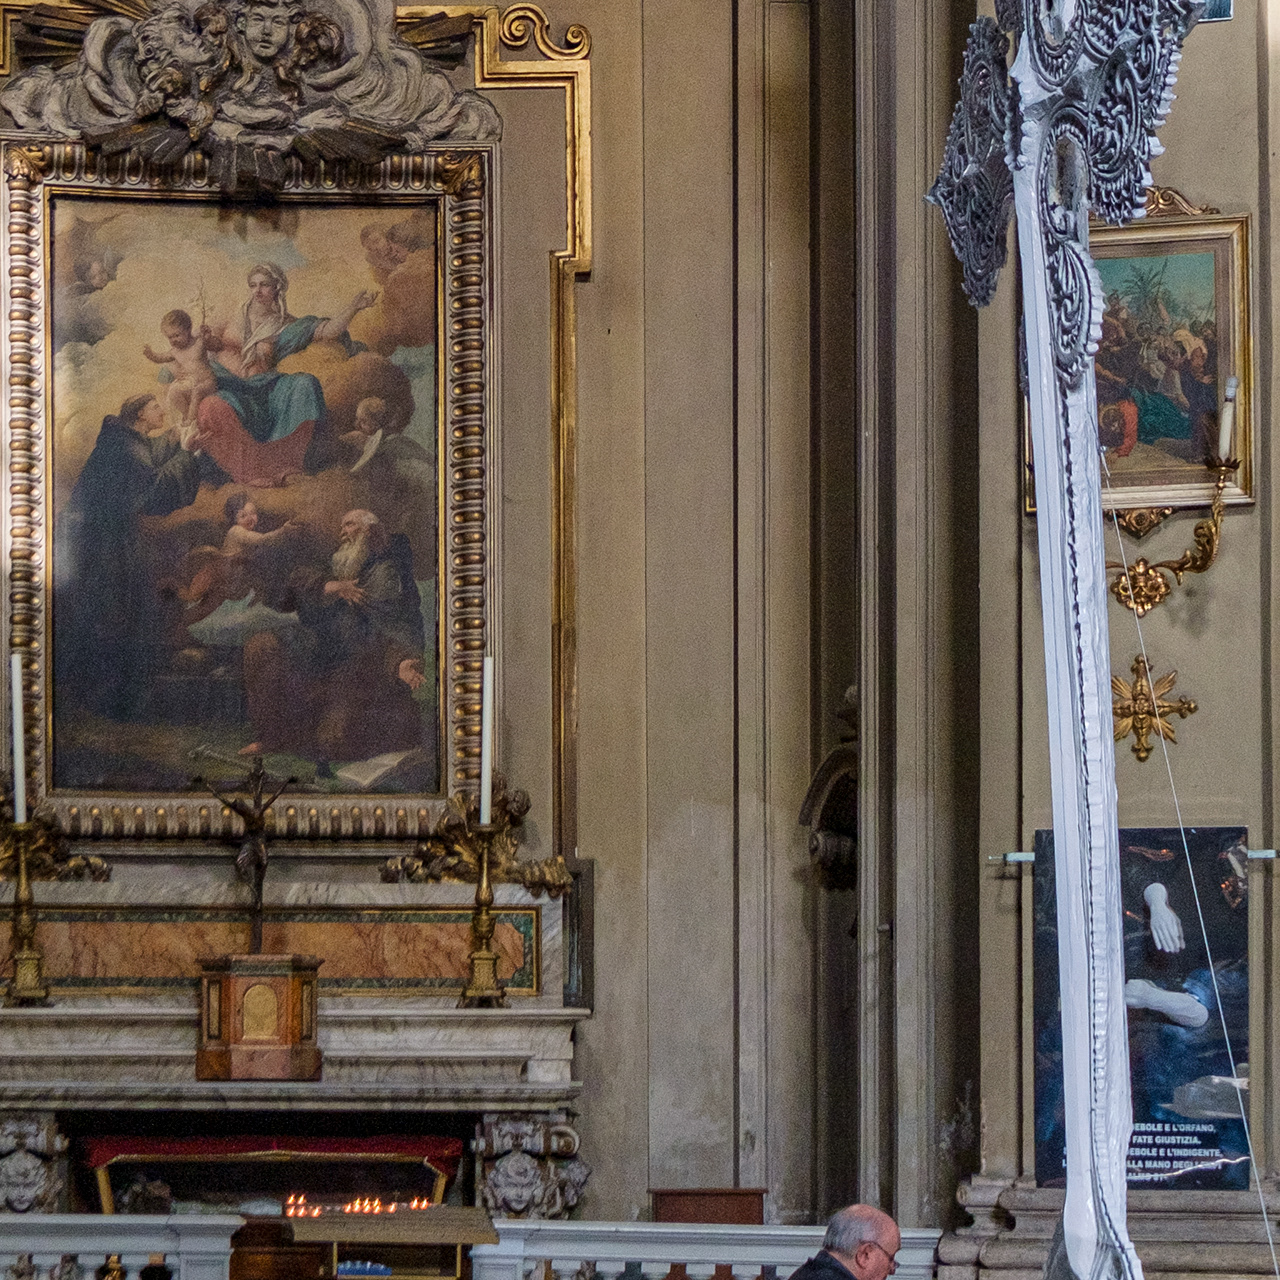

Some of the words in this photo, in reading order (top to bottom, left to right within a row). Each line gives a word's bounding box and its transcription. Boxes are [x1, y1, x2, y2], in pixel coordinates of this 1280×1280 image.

[1134, 1124, 1163, 1132] EBOLE
[1165, 1124, 1170, 1132] E
[1172, 1124, 1217, 1133] L'ORFANO,
[1133, 1136, 1153, 1144] FATE
[1155, 1136, 1201, 1144] GIUSTIZIA.
[1129, 1148, 1158, 1156] EBOLE
[1145, 1160, 1170, 1168] MANO
